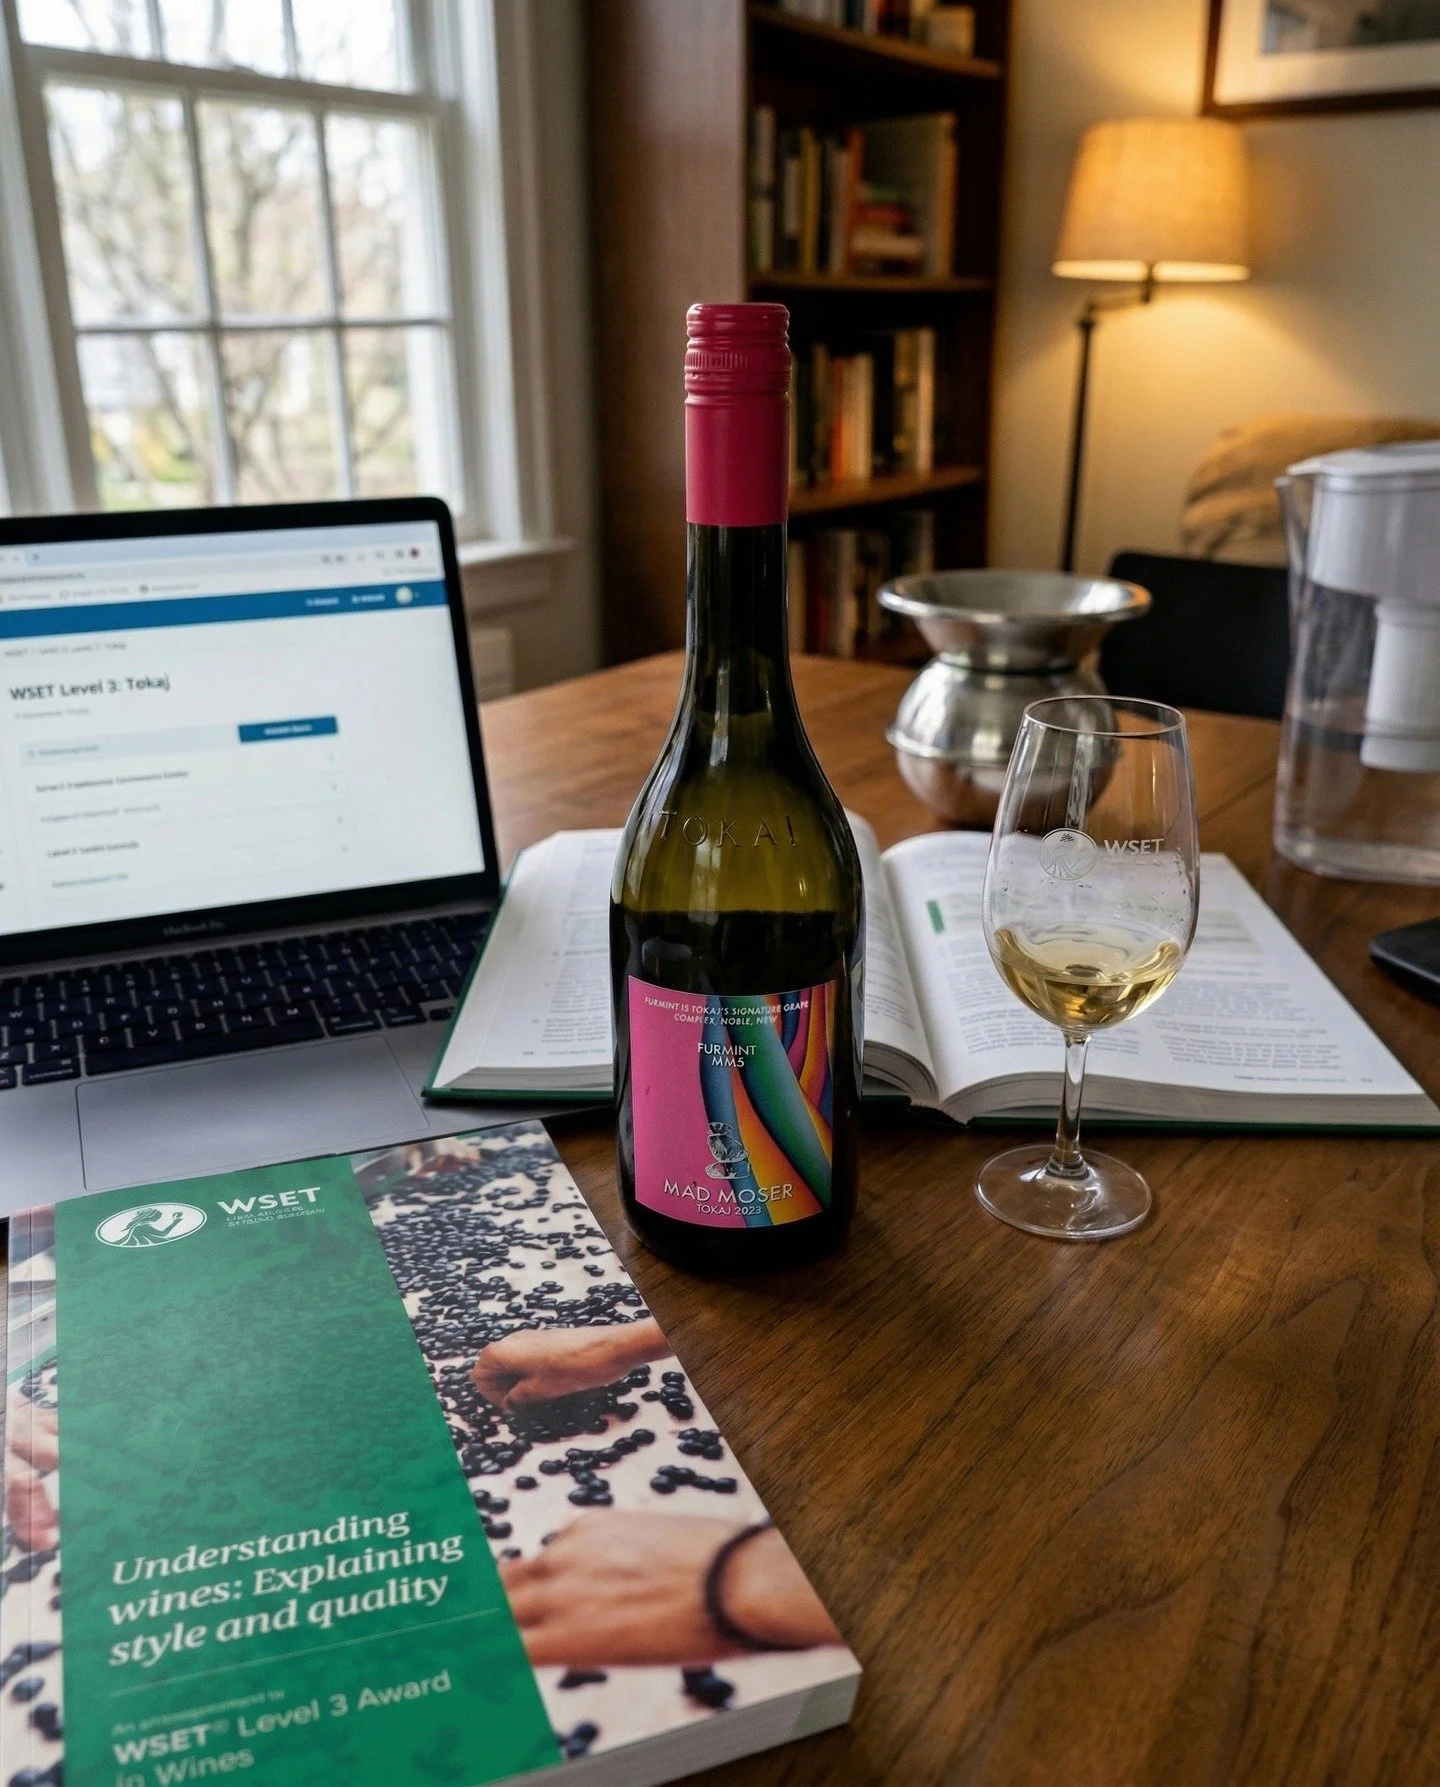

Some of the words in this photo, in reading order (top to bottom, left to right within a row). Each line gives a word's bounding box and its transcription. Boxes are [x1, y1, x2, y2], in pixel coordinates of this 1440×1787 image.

[10, 684, 55, 700] WSET
[60, 679, 103, 697] Level
[108, 678, 122, 694] 3:
[126, 674, 170, 692] Tokaj
[1103, 838, 1164, 857] WSET
[644, 997, 679, 1011] FURMINT
[681, 1003, 690, 1013] IS
[691, 1004, 729, 1015] TOKAJ'S
[732, 1004, 781, 1015] SIGNATURE
[783, 1000, 809, 1013] GRAPE
[674, 1013, 718, 1026] COMPLEX,
[720, 1016, 753, 1026] NOBLE,
[756, 1014, 778, 1025] NEW
[697, 1042, 757, 1056] FURMINT
[711, 1056, 745, 1068] MM5
[217, 1186, 321, 1215] WSET
[718, 1183, 793, 1204] MOSER
[696, 1203, 731, 1215] TOKAJ
[735, 1205, 762, 1216] 2023
[112, 1511, 411, 1585] Understanding
[107, 1577, 244, 1626] wines:
[252, 1534, 464, 1594] Explaining
[108, 1618, 207, 1668] style
[216, 1599, 298, 1643] and
[307, 1575, 449, 1630] quality
[237, 1698, 320, 1738] Level
[329, 1692, 349, 1718] 3
[357, 1669, 452, 1711] Award
[154, 1748, 255, 1787] Wines
